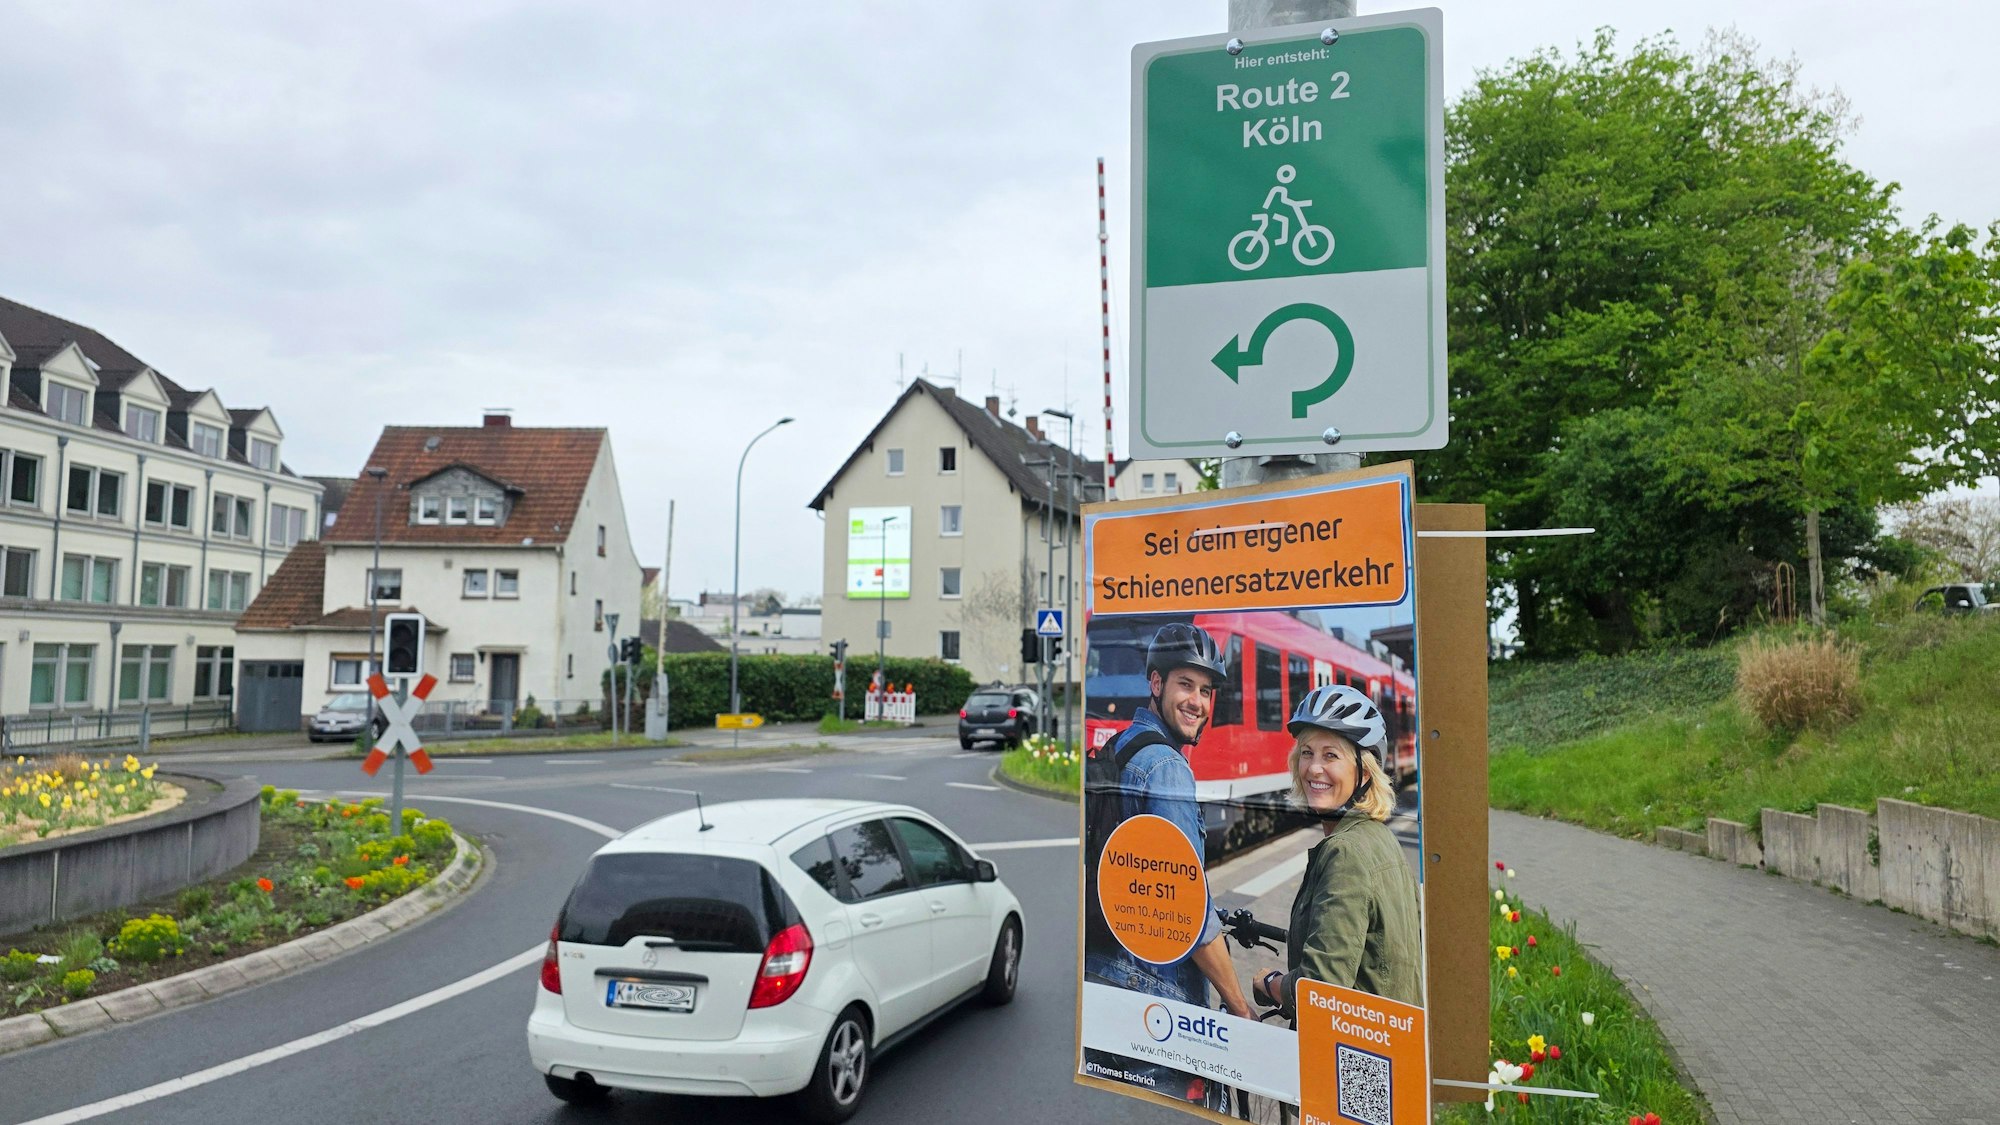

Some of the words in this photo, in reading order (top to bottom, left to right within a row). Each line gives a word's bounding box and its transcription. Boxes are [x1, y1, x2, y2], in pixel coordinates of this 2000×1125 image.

[1234, 56, 1263, 69] Hier
[1267, 48, 1330, 66] entsteht:
[1216, 77, 1319, 112] Route
[1330, 71, 1350, 100] 2
[1243, 115, 1322, 148] Köln
[1144, 529, 1179, 557] Sei
[1186, 524, 1236, 553] dein
[1244, 517, 1343, 553] eigener
[1102, 557, 1395, 600] Schienenersatzverkehr
[1107, 850, 1198, 881] Vollsperrung
[1129, 879, 1152, 896] der
[1155, 882, 1176, 900] S11
[1114, 904, 1136, 915] vom
[1138, 905, 1151, 918] 10.
[1152, 908, 1175, 922] April
[1177, 912, 1192, 925] bis
[1115, 921, 1136, 933] zum
[1138, 923, 1147, 935] 3.
[1148, 925, 1164, 938] Juli
[1167, 928, 1191, 943] 2026
[1309, 990, 1386, 1025] Radrouten
[1388, 1014, 1414, 1033] auf
[1177, 1014, 1229, 1043] adfc
[1331, 1015, 1391, 1047] Komoot
[1123, 1070, 1156, 1087] Eschrich
